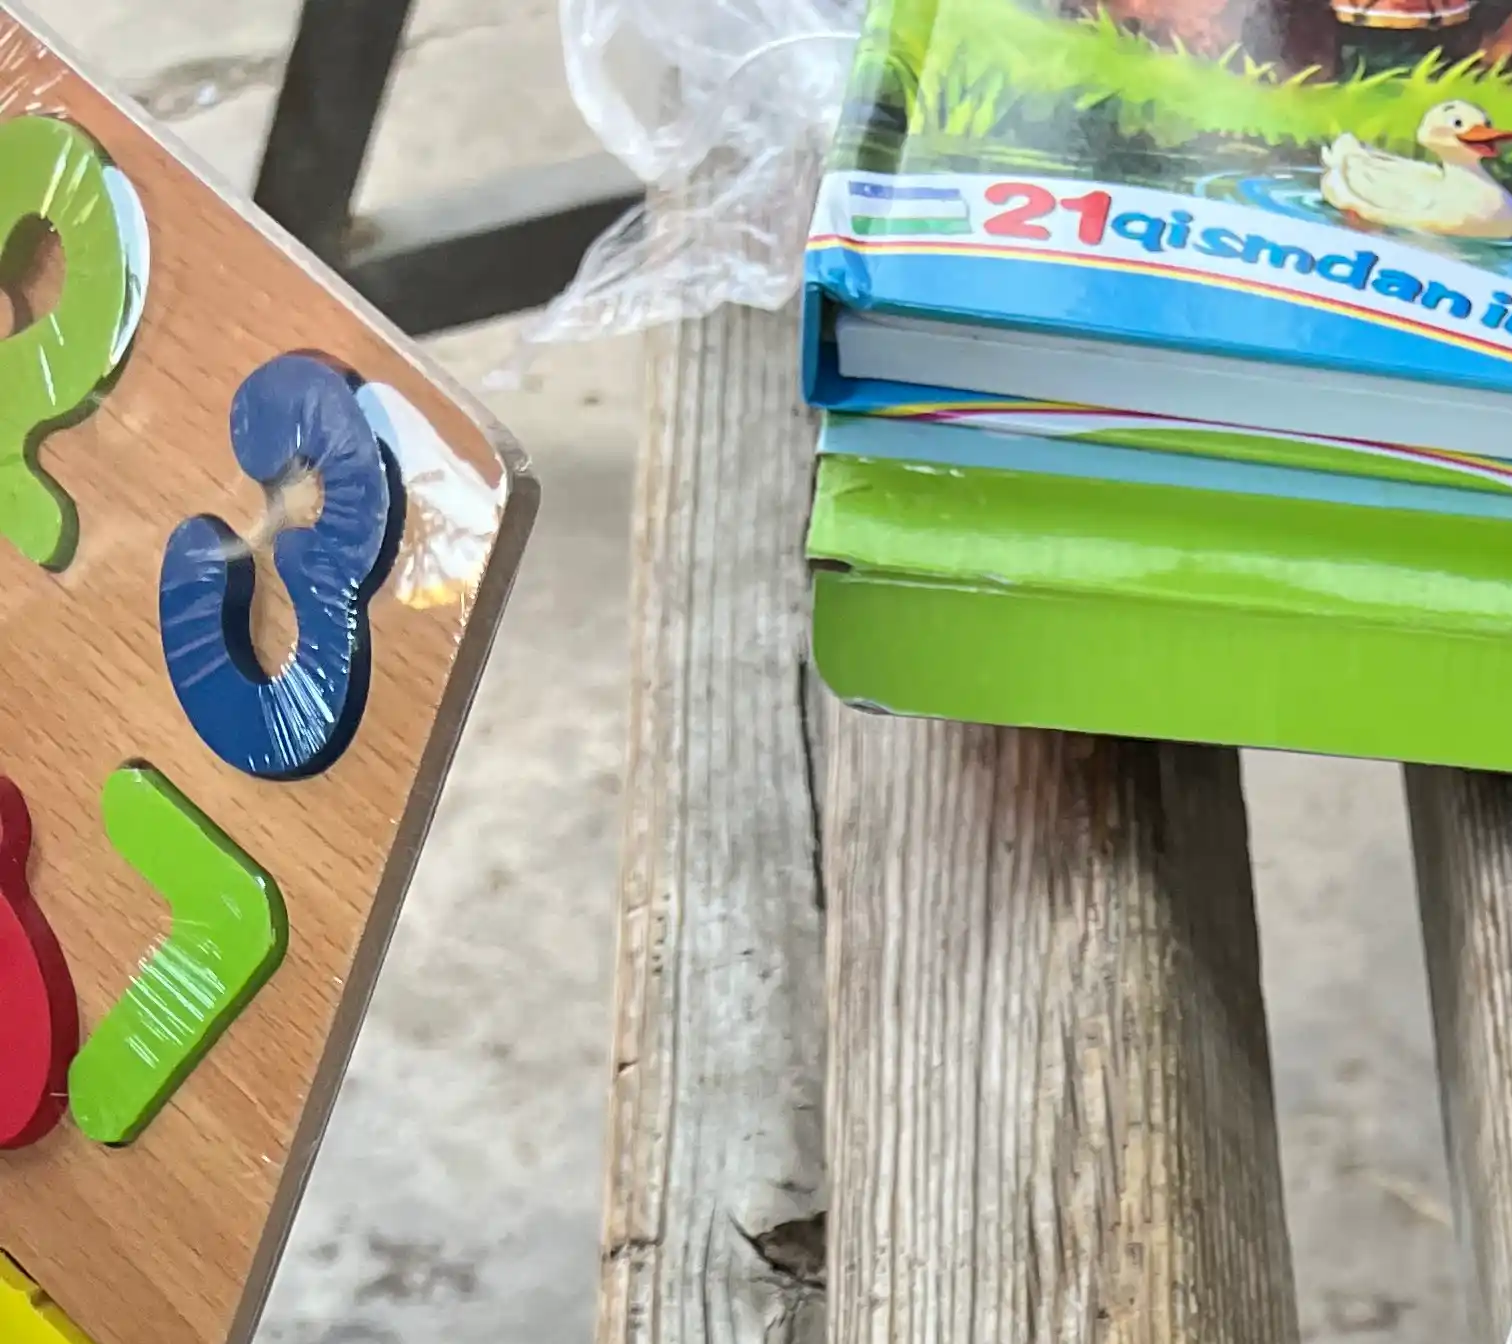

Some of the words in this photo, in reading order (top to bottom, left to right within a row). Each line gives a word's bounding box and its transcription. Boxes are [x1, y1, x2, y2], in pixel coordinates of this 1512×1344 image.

[984, 182, 1111, 246] 21
[1110, 210, 1473, 320] qismdan
[160, 352, 402, 782] 3
[69, 758, 289, 1146] 7
